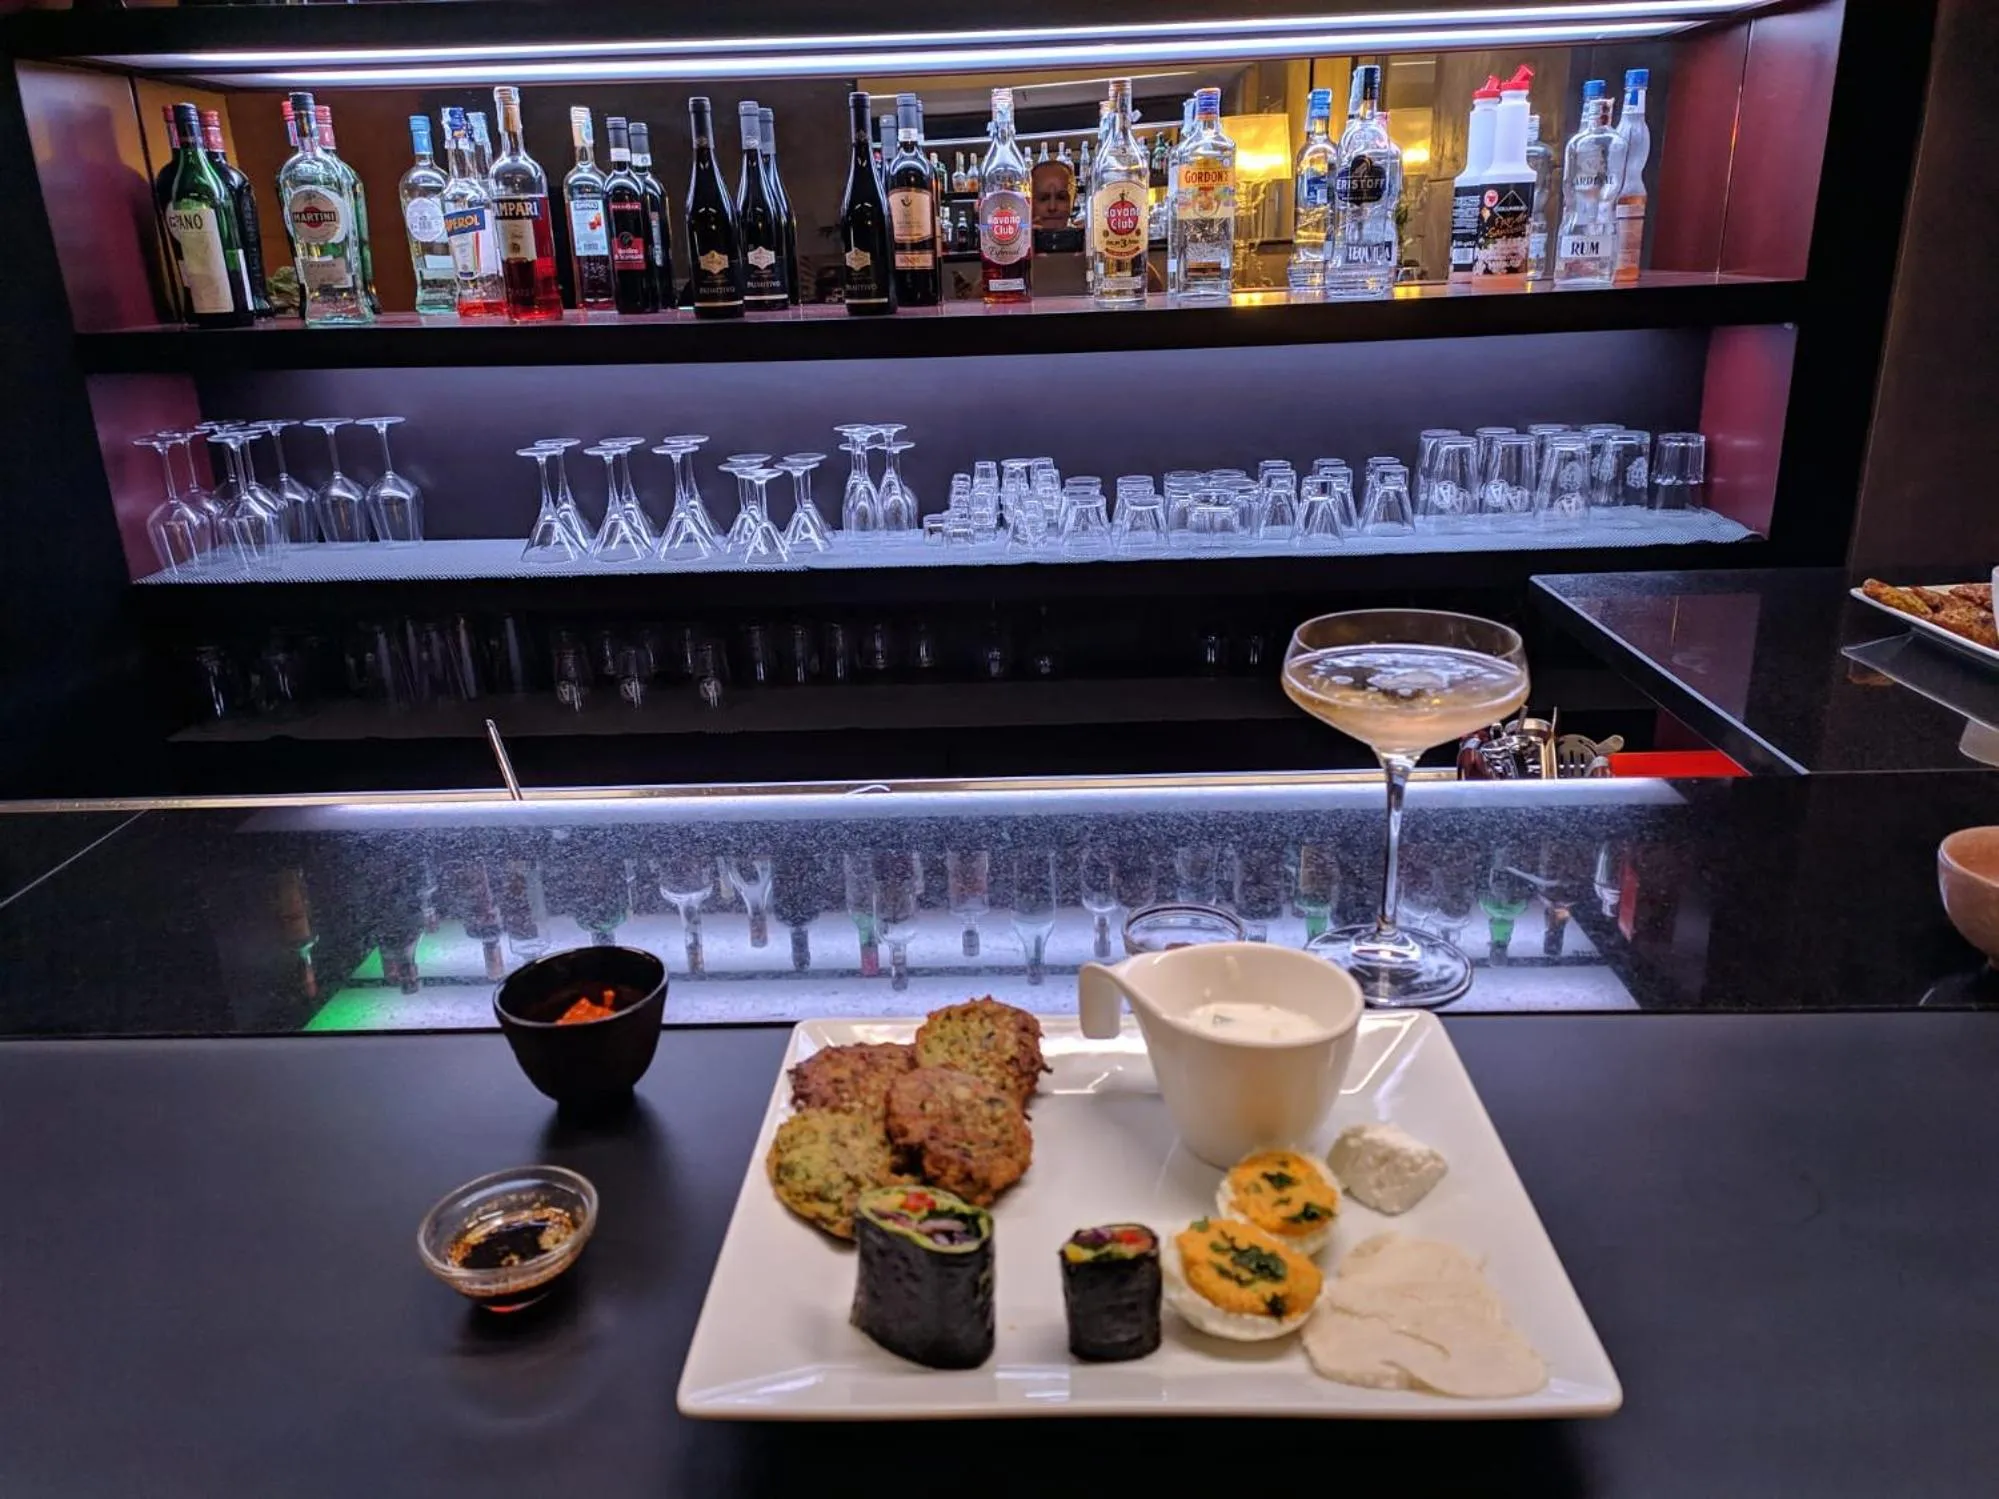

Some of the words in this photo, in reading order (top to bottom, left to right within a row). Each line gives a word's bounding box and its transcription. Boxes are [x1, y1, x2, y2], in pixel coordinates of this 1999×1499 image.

[1336, 178, 1385, 191] ERISTOFF
[293, 212, 336, 222] MARTINI
[1110, 218, 1135, 230] Club
[993, 227, 1015, 236] Club
[1570, 241, 1600, 256] RUM
